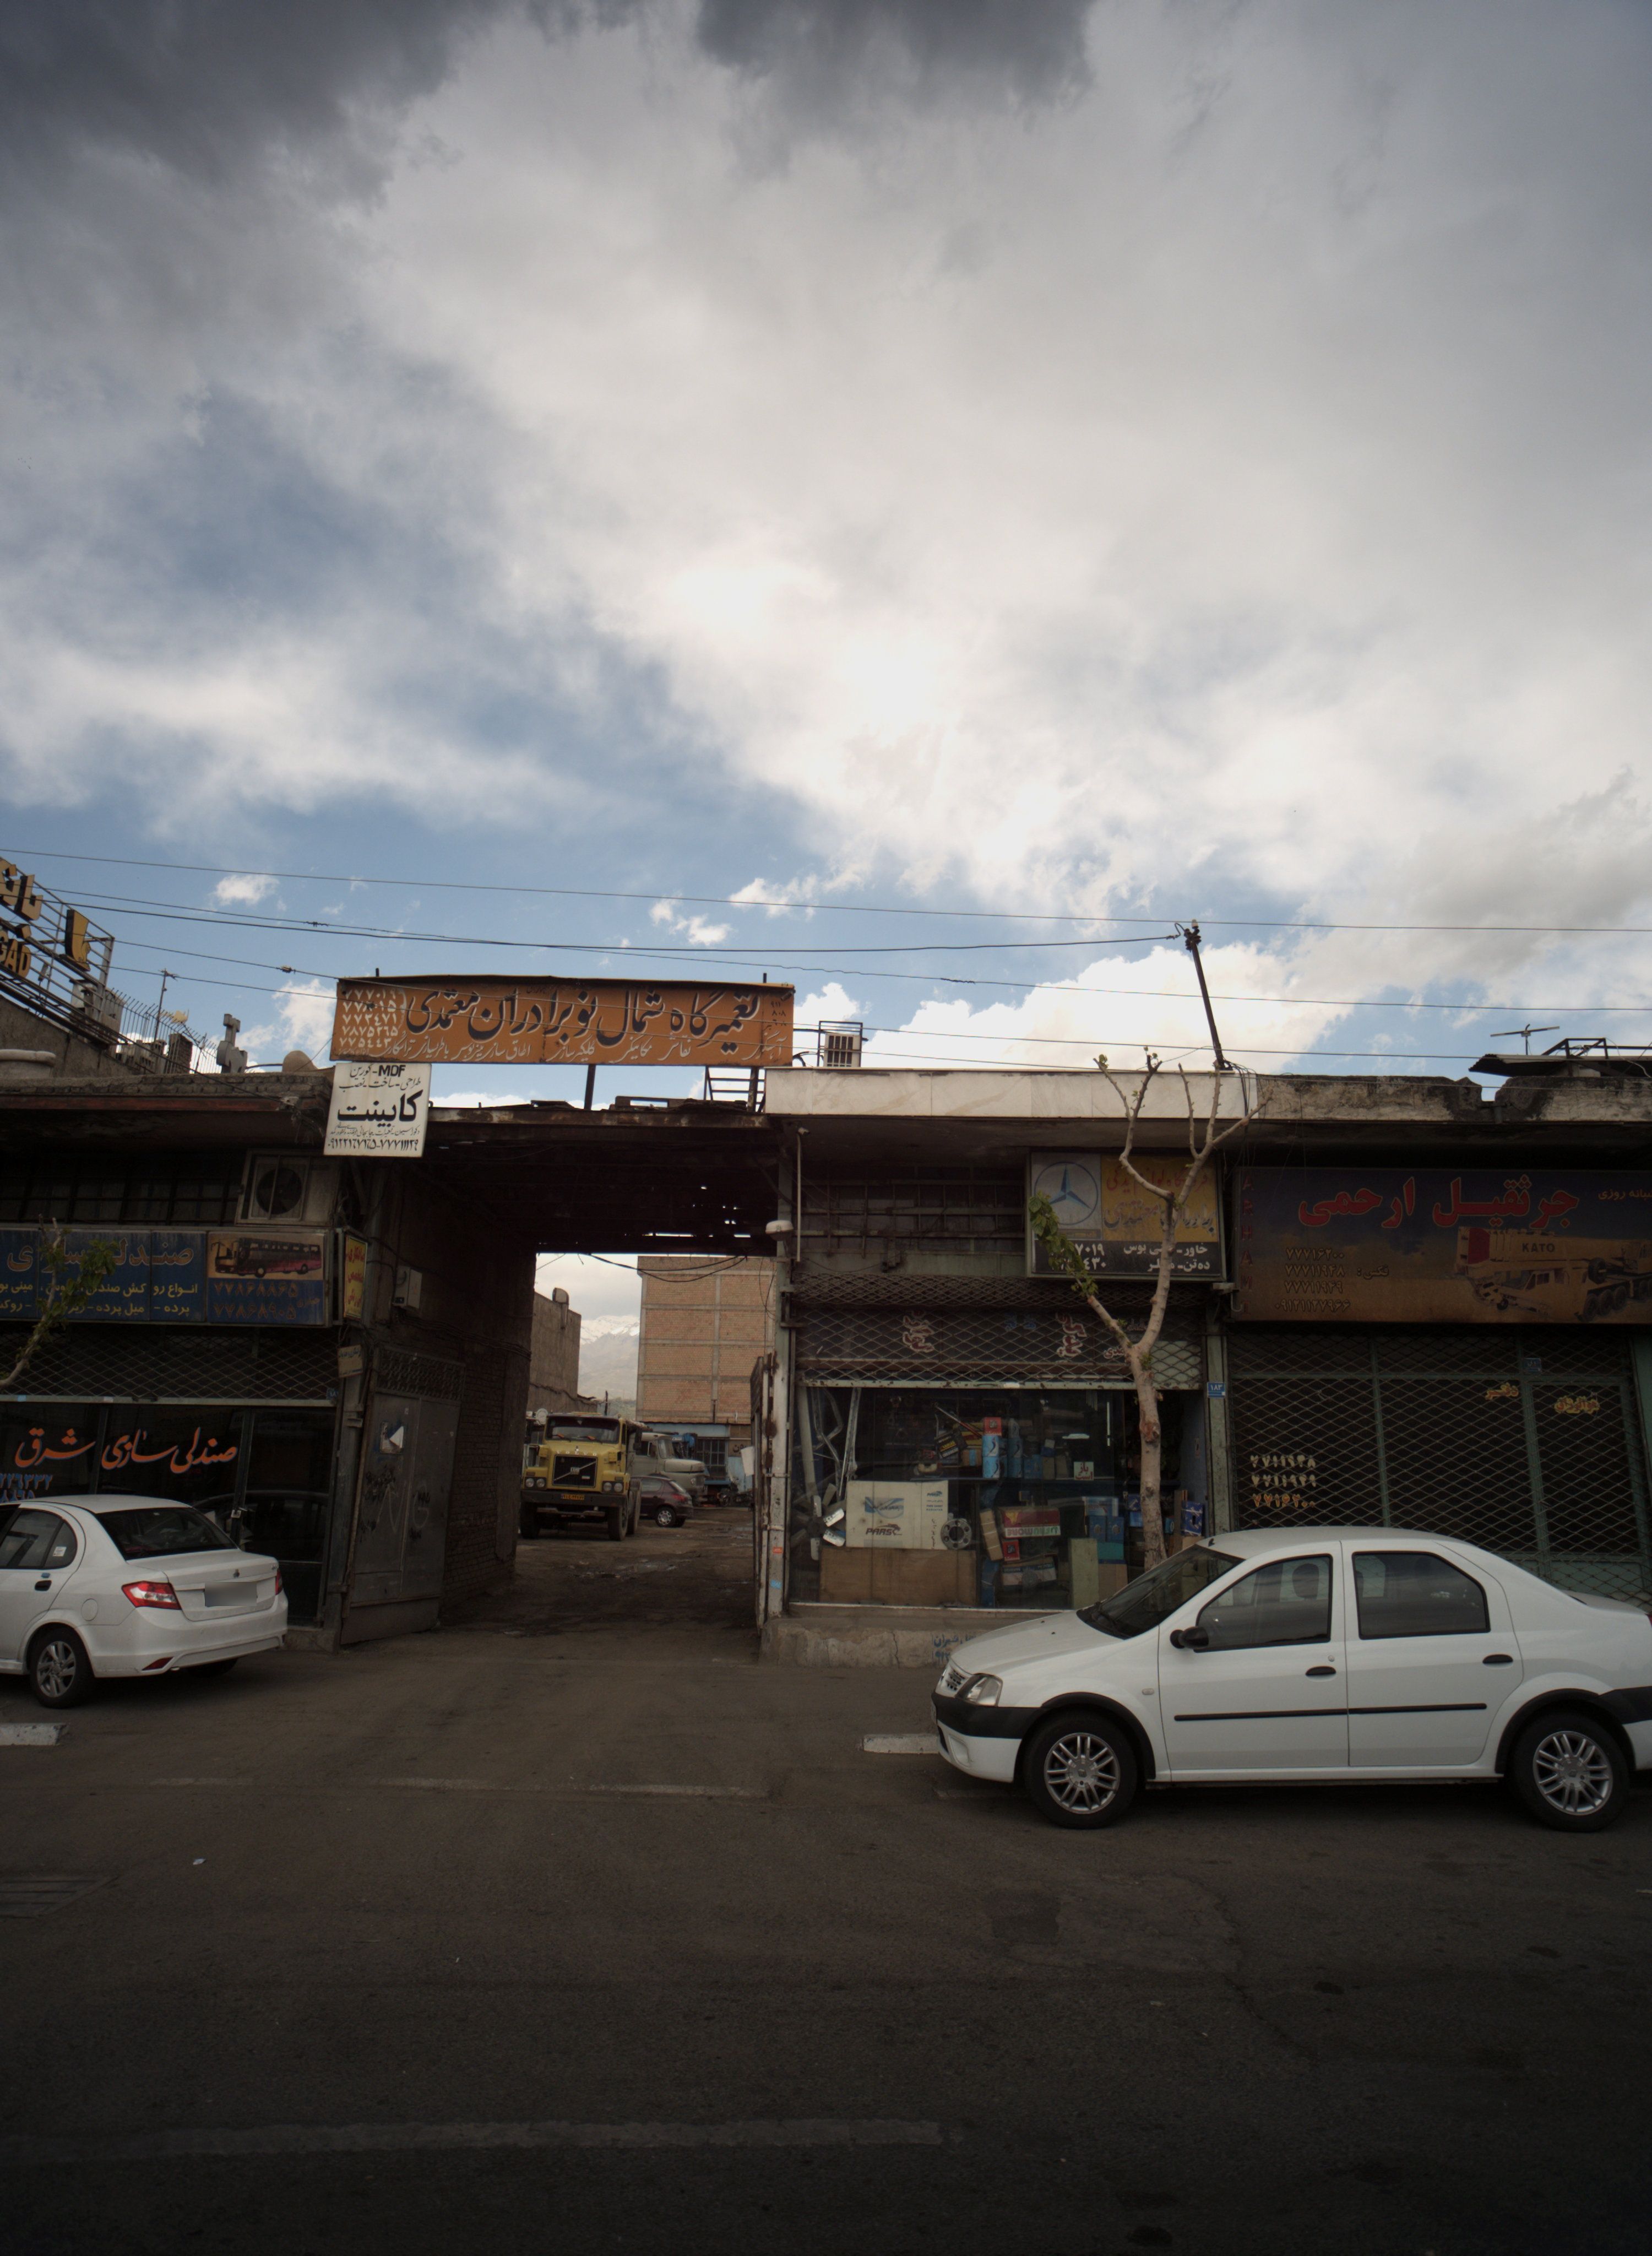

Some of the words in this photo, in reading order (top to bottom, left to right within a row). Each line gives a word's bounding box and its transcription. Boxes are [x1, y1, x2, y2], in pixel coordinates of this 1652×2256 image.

[406, 989, 480, 1035] معتمدی
[596, 990, 665, 1048] شمال
[506, 1040, 531, 1060] اطاق
[378, 1065, 406, 1077] MDF
[339, 1078, 366, 1093] نصب
[368, 1077, 394, 1088] ساخت
[400, 1077, 422, 1091] طراحی
[338, 1089, 423, 1127] کابینت
[1298, 1176, 1416, 1228] ارحمی
[1123, 1243, 1147, 1255] بوس
[1184, 1243, 1208, 1256] خاور
[1522, 1243, 1555, 1253] KATO
[167, 1283, 198, 1295] انواع
[96, 1303, 122, 1316] پرده
[124, 1302, 145, 1316] میل
[164, 1303, 190, 1316] پرده
[14, 1427, 97, 1468] شرق
[101, 1428, 179, 1471] سازی
[169, 1426, 239, 1474] صندلی
